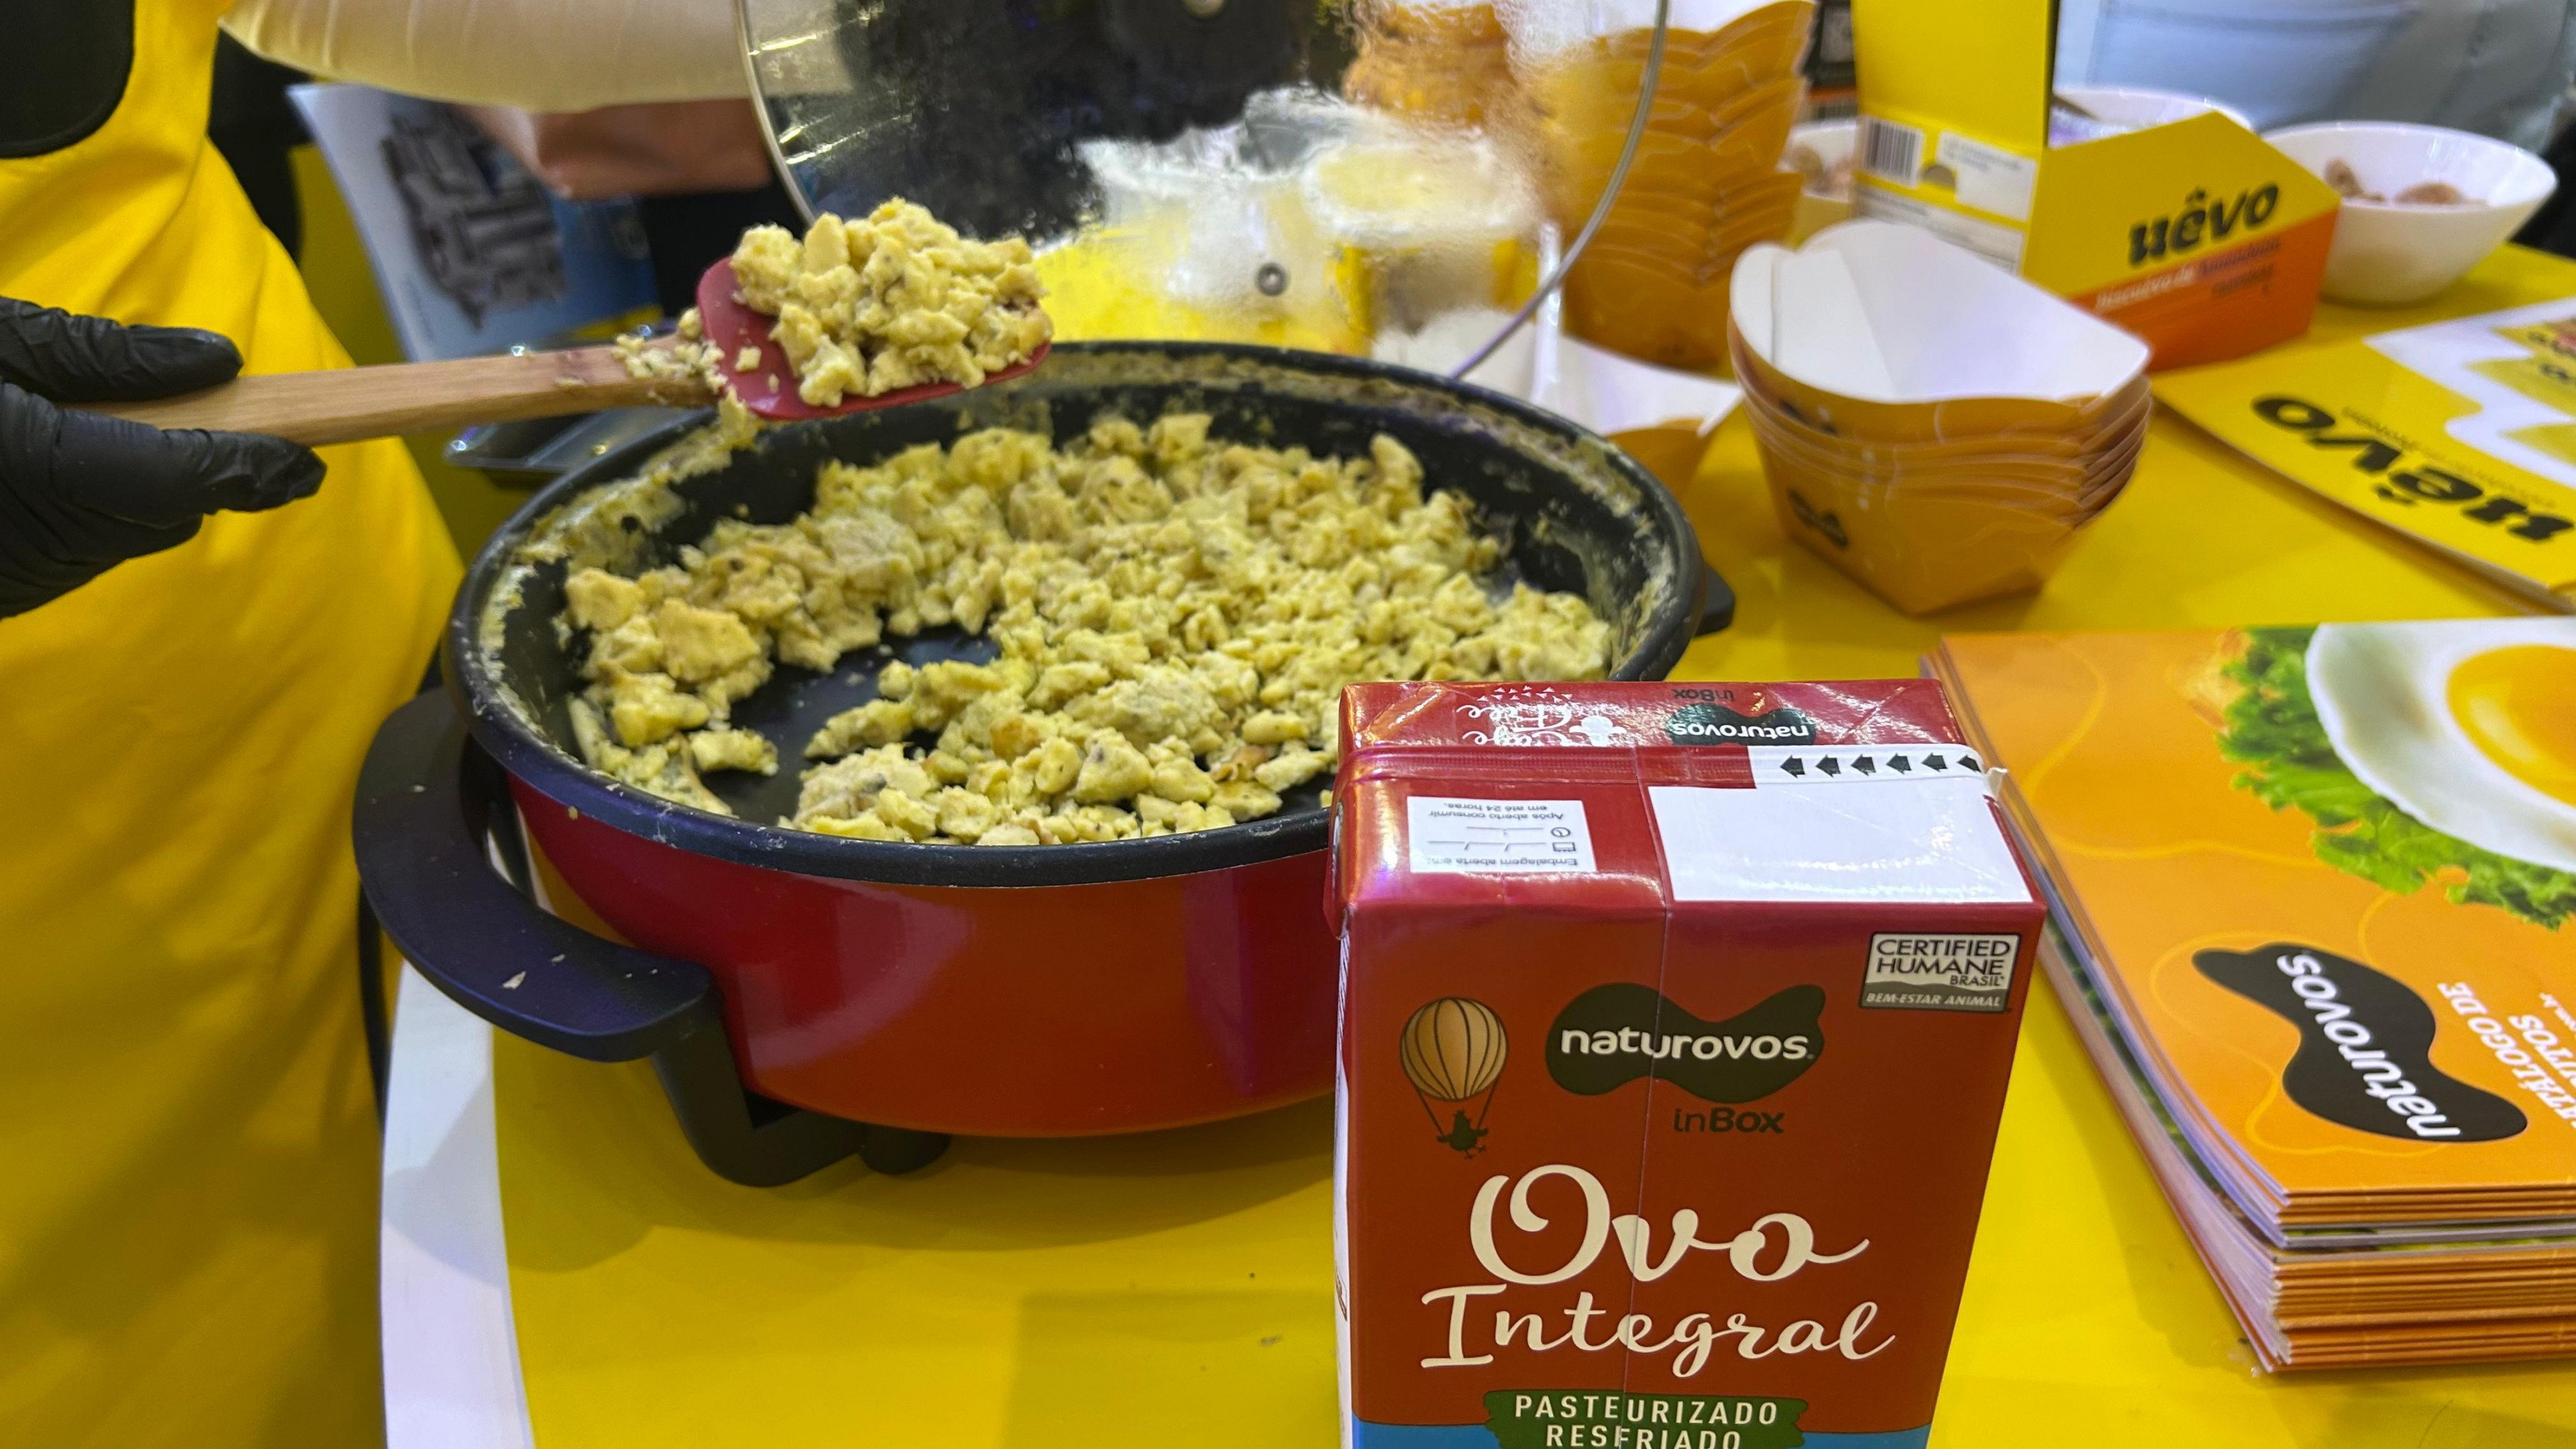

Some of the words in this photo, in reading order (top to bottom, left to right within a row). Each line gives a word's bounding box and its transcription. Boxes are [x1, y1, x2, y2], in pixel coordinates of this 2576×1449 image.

[2128, 182, 2279, 266] uêvo
[2250, 394, 2575, 541] uêvo
[1673, 722, 1809, 739] naturovos
[1429, 810, 1486, 818] consumir
[1444, 802, 1483, 811] horas.
[1488, 810, 1528, 820] aberto
[1505, 804, 1524, 812] até
[1532, 811, 1564, 820] Após
[1456, 856, 1496, 865] aberta
[1500, 856, 1579, 866] Embalagem
[1876, 939, 2011, 957] CERTIFIED
[1876, 958, 2004, 976] HUMANE
[1950, 975, 2001, 986] BRASIL
[1866, 993, 1941, 1005] BEM-ESTAR
[1944, 996, 2001, 1006] ANIMAL
[2436, 981, 2489, 1015] DE
[1561, 1026, 1810, 1060] naturovos
[2277, 954, 2462, 1137] naturovos
[2467, 1017, 2576, 1130] ATÁLOGO
[1673, 1107, 1785, 1135] inBox
[1470, 1164, 1870, 1285] Ovo
[1420, 1284, 1896, 1378] Integral
[1515, 1394, 1778, 1426] PASTEURIZADO
[1546, 1424, 1741, 1449] RESFRIADO
